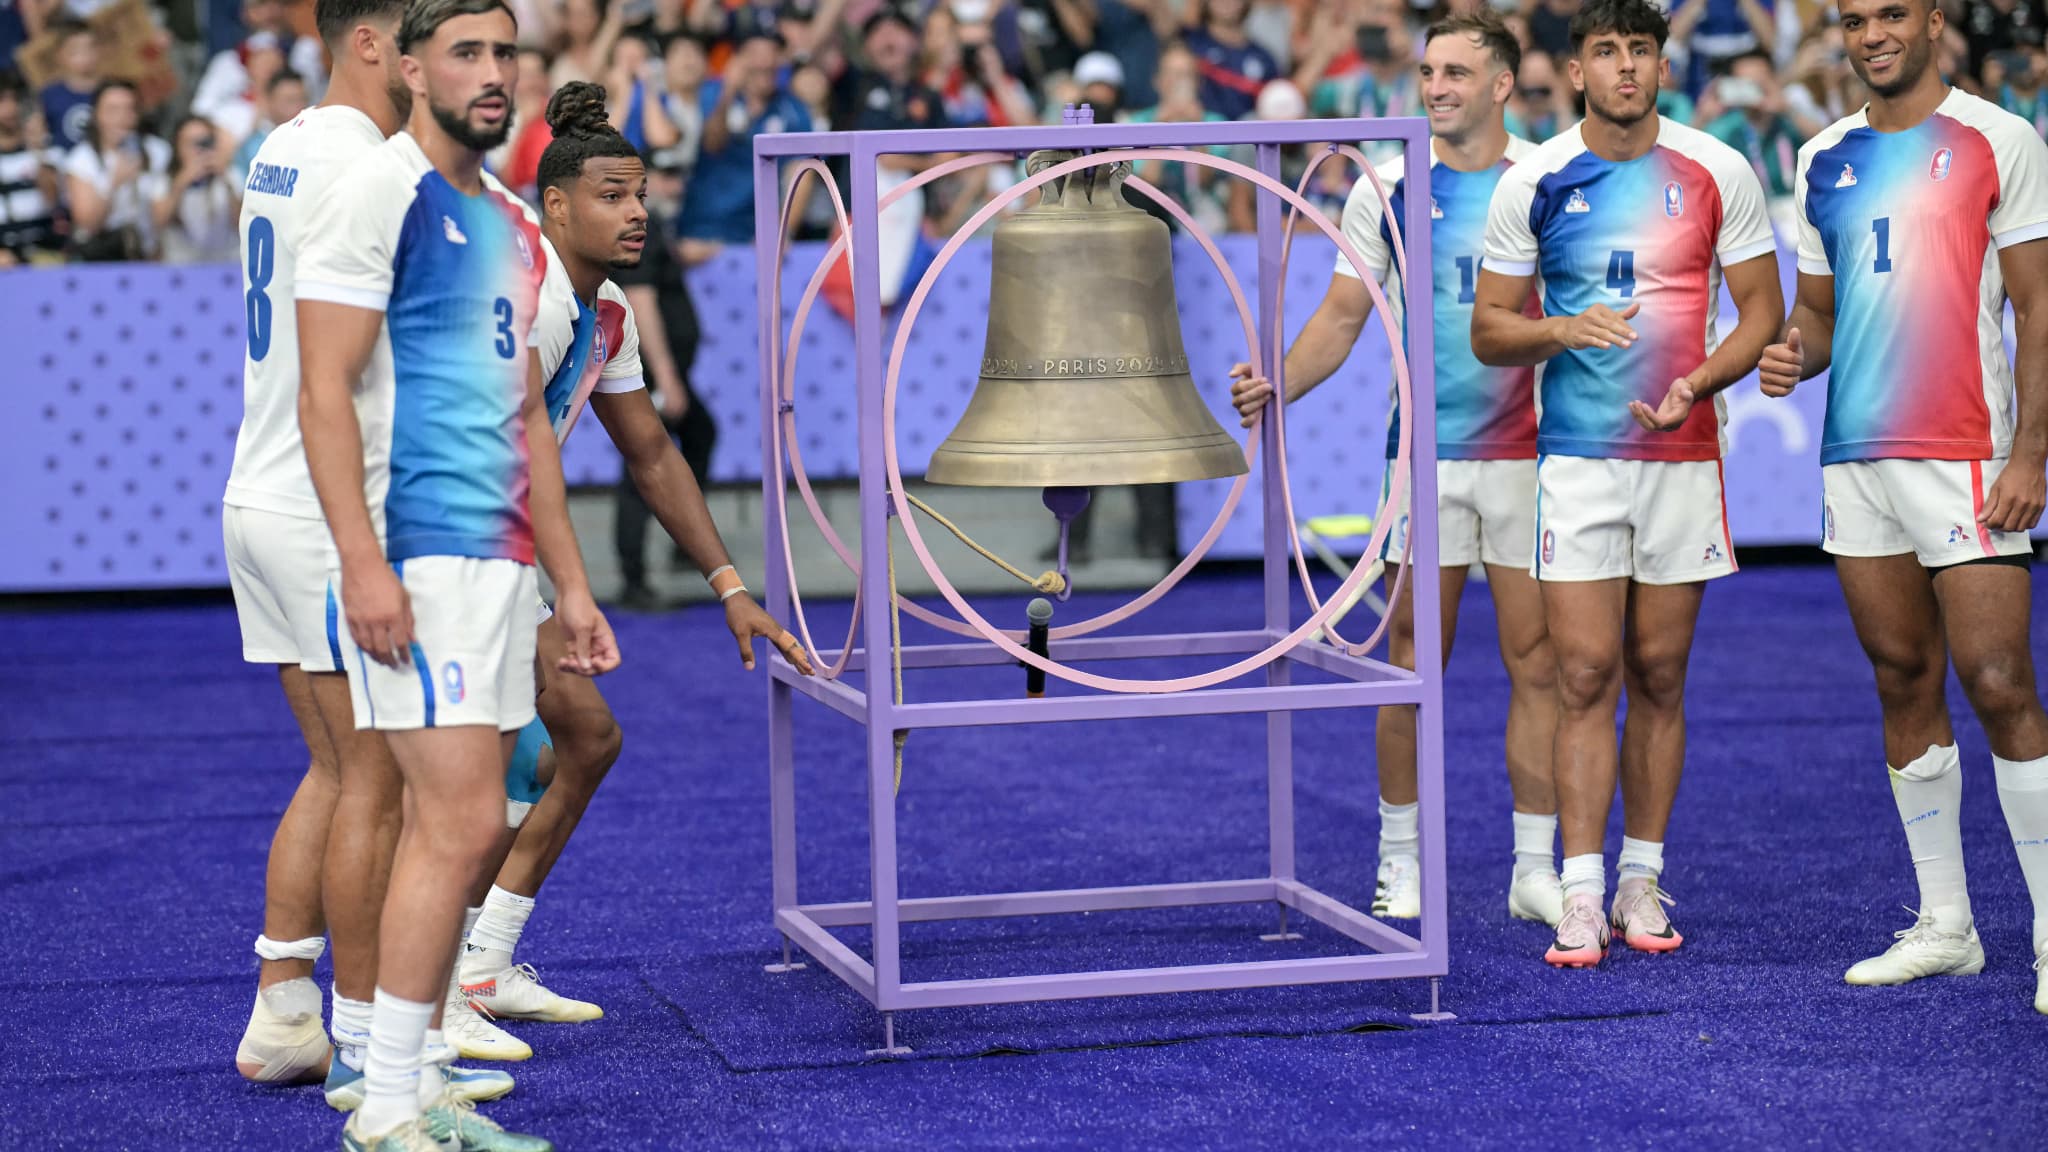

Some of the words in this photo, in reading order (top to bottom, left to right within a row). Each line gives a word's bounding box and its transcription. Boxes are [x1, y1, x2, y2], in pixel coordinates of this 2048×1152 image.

[247, 161, 299, 198] ZEGHDAR
[1872, 216, 1892, 274] 1
[247, 216, 275, 362] 8
[1455, 255, 1485, 304] 1
[1606, 250, 1636, 298] 4
[494, 297, 516, 360] 3
[1044, 359, 1107, 375] PARIS
